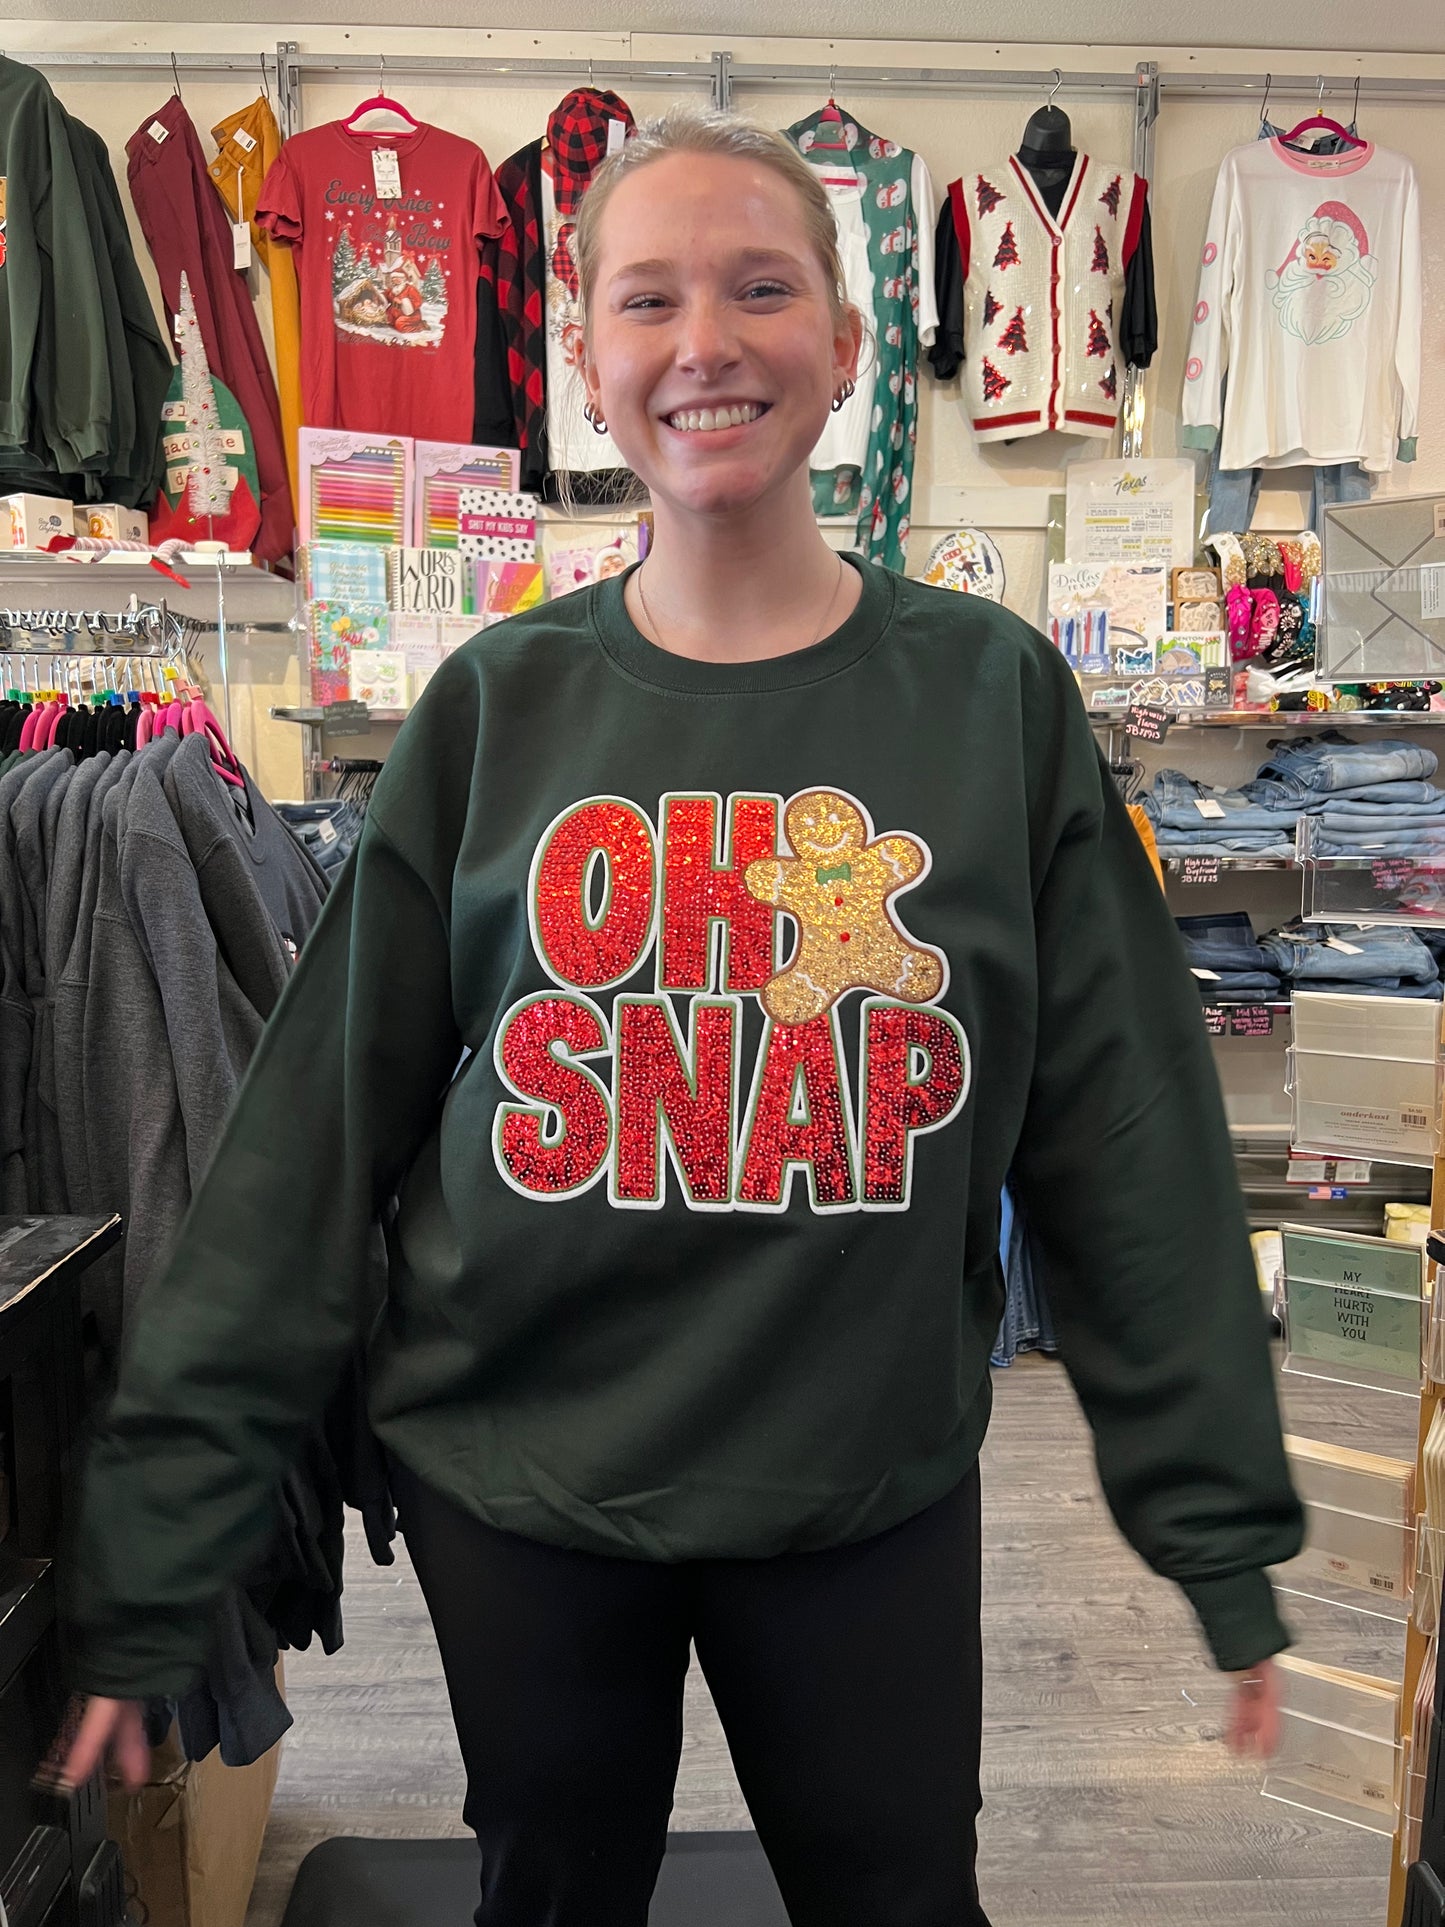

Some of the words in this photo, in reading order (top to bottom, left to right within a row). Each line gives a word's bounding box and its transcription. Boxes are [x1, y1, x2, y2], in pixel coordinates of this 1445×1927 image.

[406, 222, 451, 250] Bow
[1113, 475, 1148, 497] Texas
[527, 792, 786, 995] OH
[492, 990, 971, 1214] SNAP
[1343, 1270, 1362, 1283] MY
[1334, 1282, 1373, 1299] HEART
[1333, 1297, 1375, 1314] HURTS
[1337, 1311, 1369, 1328] WITH
[1341, 1326, 1366, 1341] YOU
